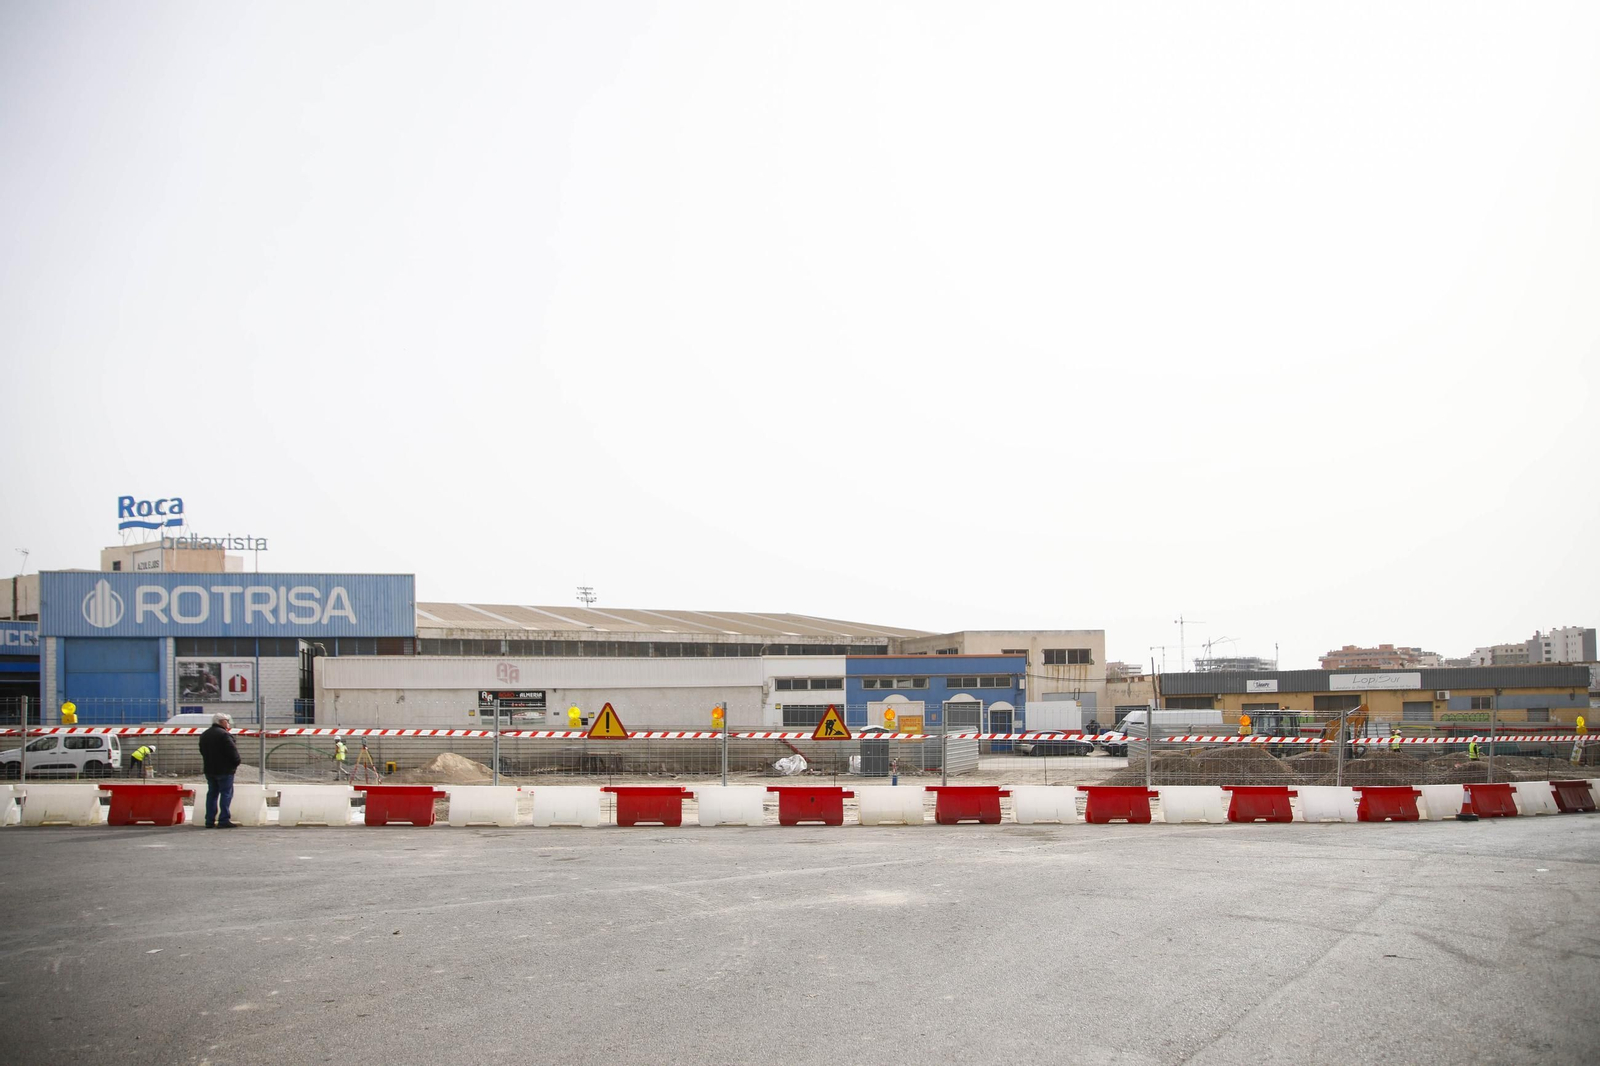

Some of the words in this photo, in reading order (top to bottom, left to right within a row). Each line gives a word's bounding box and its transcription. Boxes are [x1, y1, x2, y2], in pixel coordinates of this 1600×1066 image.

[118, 495, 184, 519] Roca
[161, 531, 268, 551] bellavista
[137, 559, 160, 571] AZULEJOS
[135, 585, 357, 625] ROTRISA
